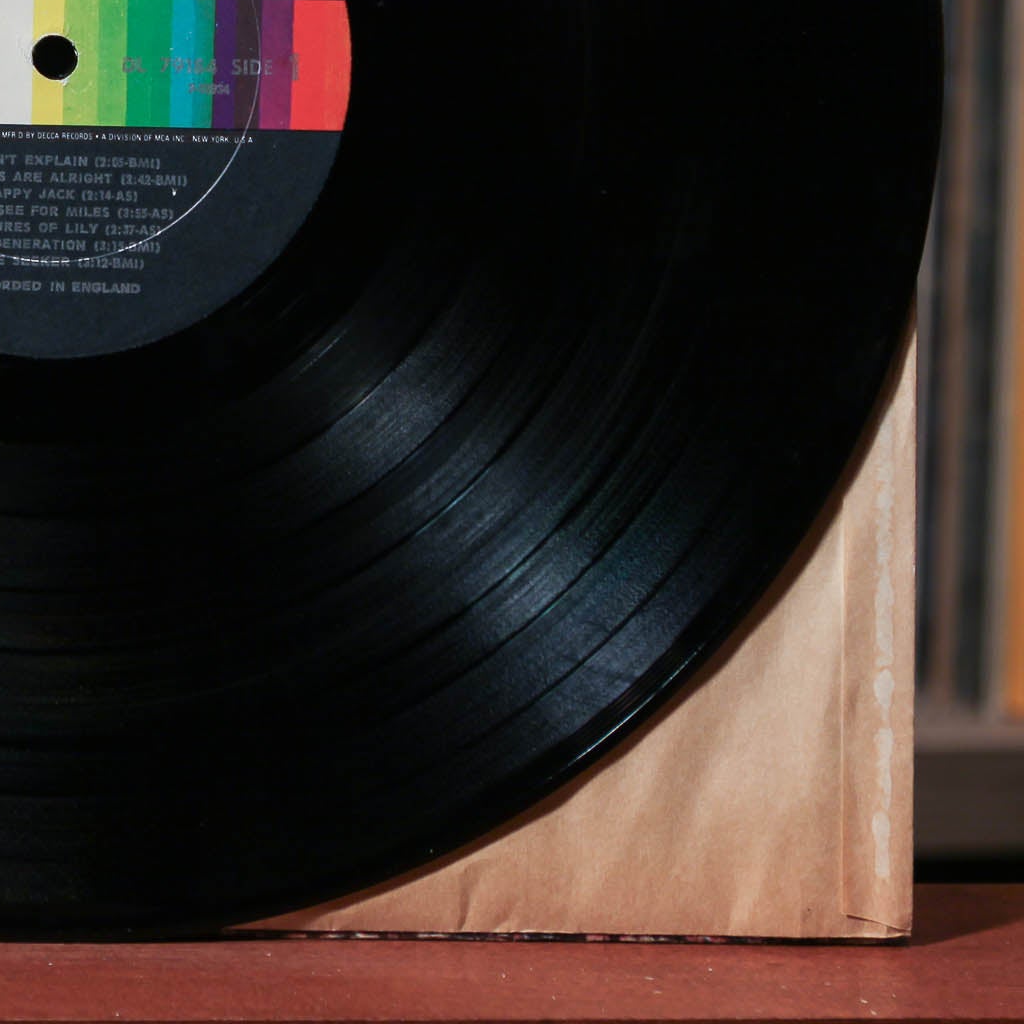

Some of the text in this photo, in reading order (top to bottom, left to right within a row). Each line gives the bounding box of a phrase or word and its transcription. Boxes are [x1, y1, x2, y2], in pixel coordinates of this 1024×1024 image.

[231, 58, 273, 76] SIDE
[37, 132, 60, 140] DECCA
[61, 132, 93, 140] RECORDS
[108, 133, 142, 141] DIVISION
[154, 134, 170, 142] MCA
[192, 135, 209, 143] NEW
[25, 155, 89, 167] EXPLAIN
[12, 171, 43, 183] ARE
[50, 172, 113, 184] ALRIGHT
[39, 188, 76, 200] JACK
[31, 205, 59, 217] FOR
[66, 206, 110, 218] MILES
[38, 222, 58, 233] OF
[66, 222, 99, 234] LILY
[12, 255, 70, 267] SEEKER
[50, 280, 65, 292] IN
[71, 281, 141, 294] ENGLAND
